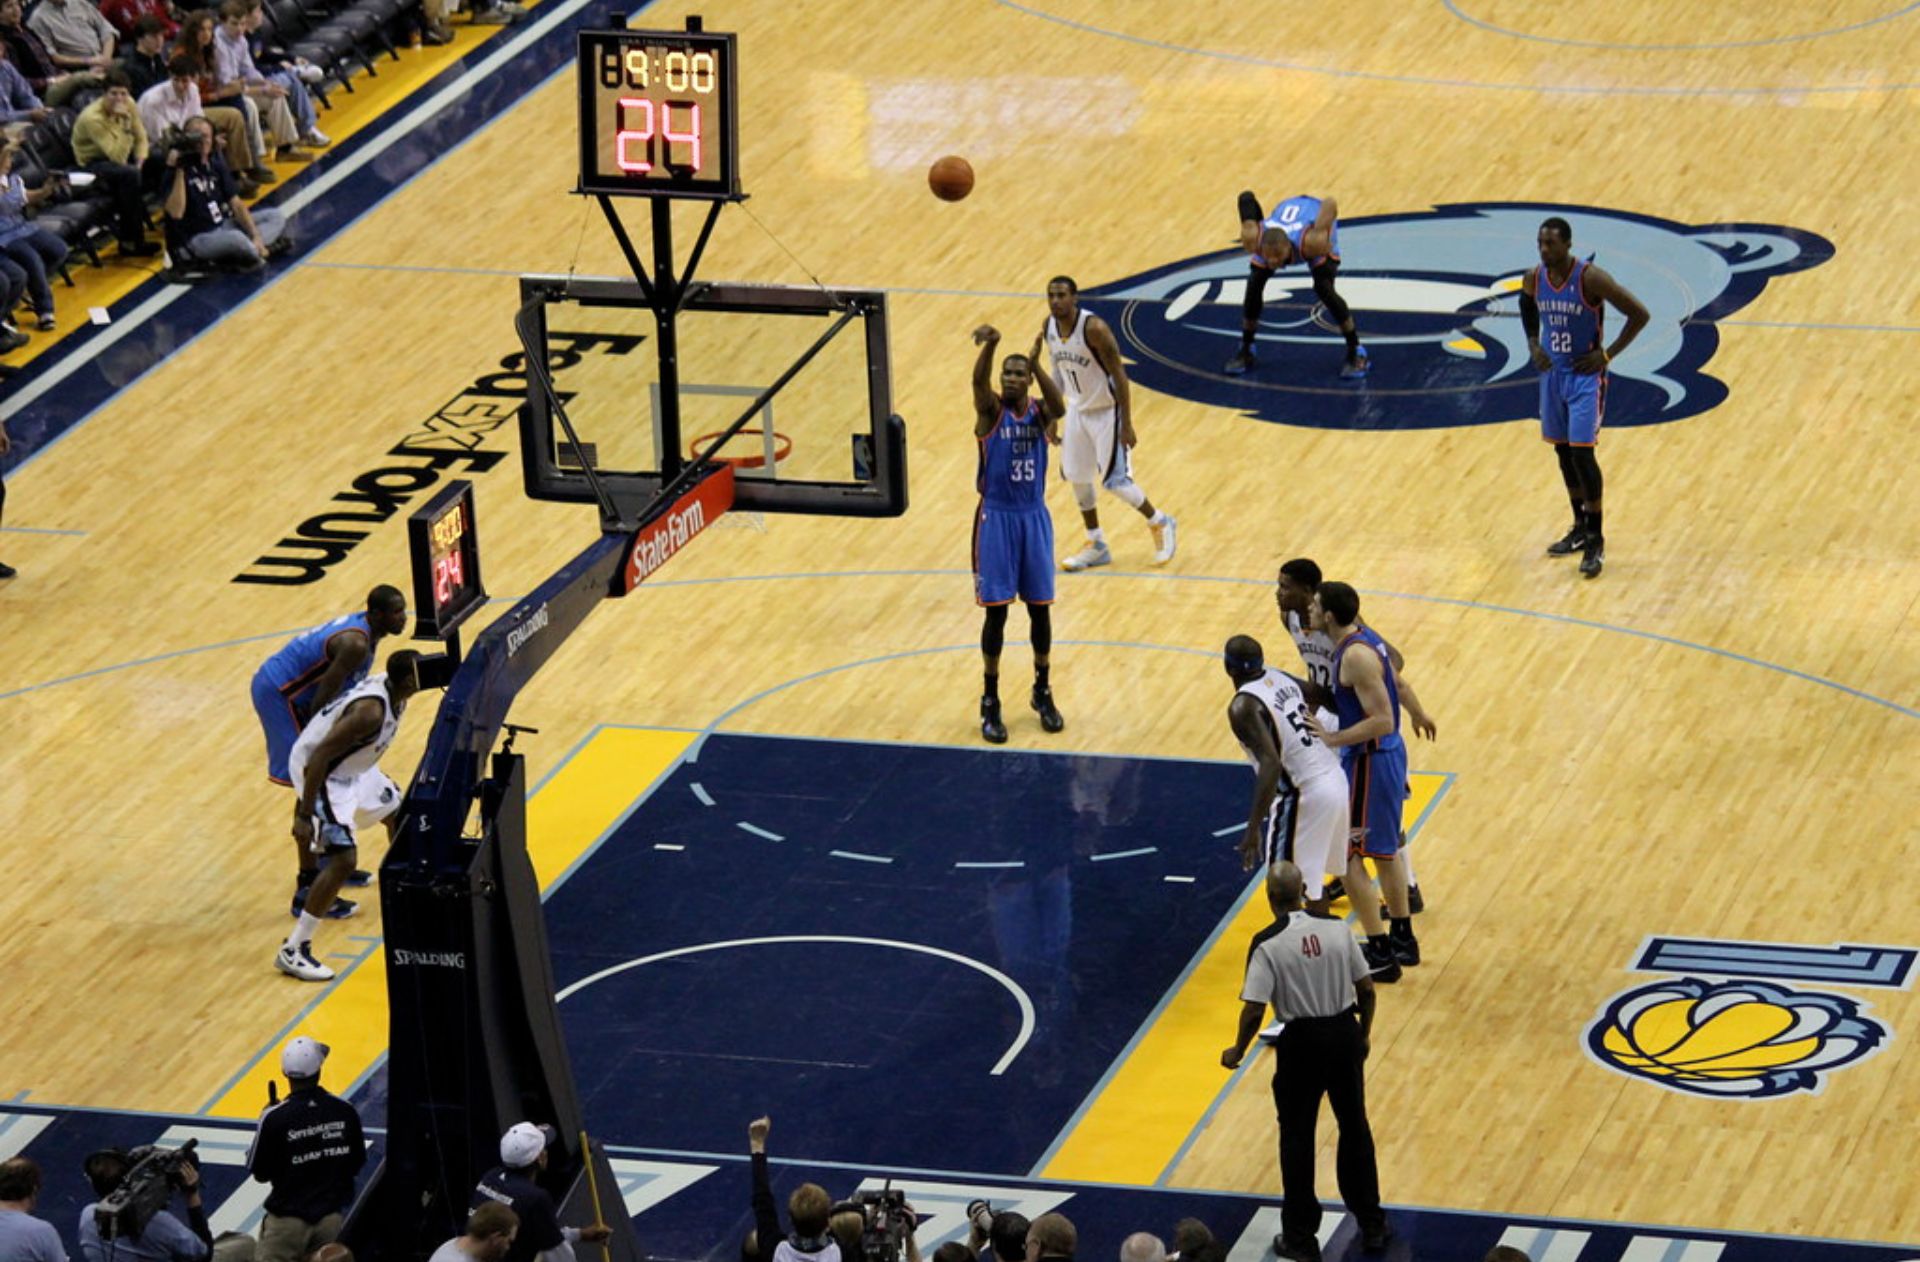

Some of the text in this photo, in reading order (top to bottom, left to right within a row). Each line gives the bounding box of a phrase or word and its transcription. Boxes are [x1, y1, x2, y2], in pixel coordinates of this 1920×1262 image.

[617, 98, 700, 171] 24
[1281, 206, 1300, 223] 0
[1551, 332, 1572, 353] 22
[1011, 459, 1035, 481] 35
[437, 551, 462, 602] 24
[1302, 934, 1321, 959] 40
[394, 948, 466, 969] SPALDING
[323, 1146, 350, 1156] TEAM
